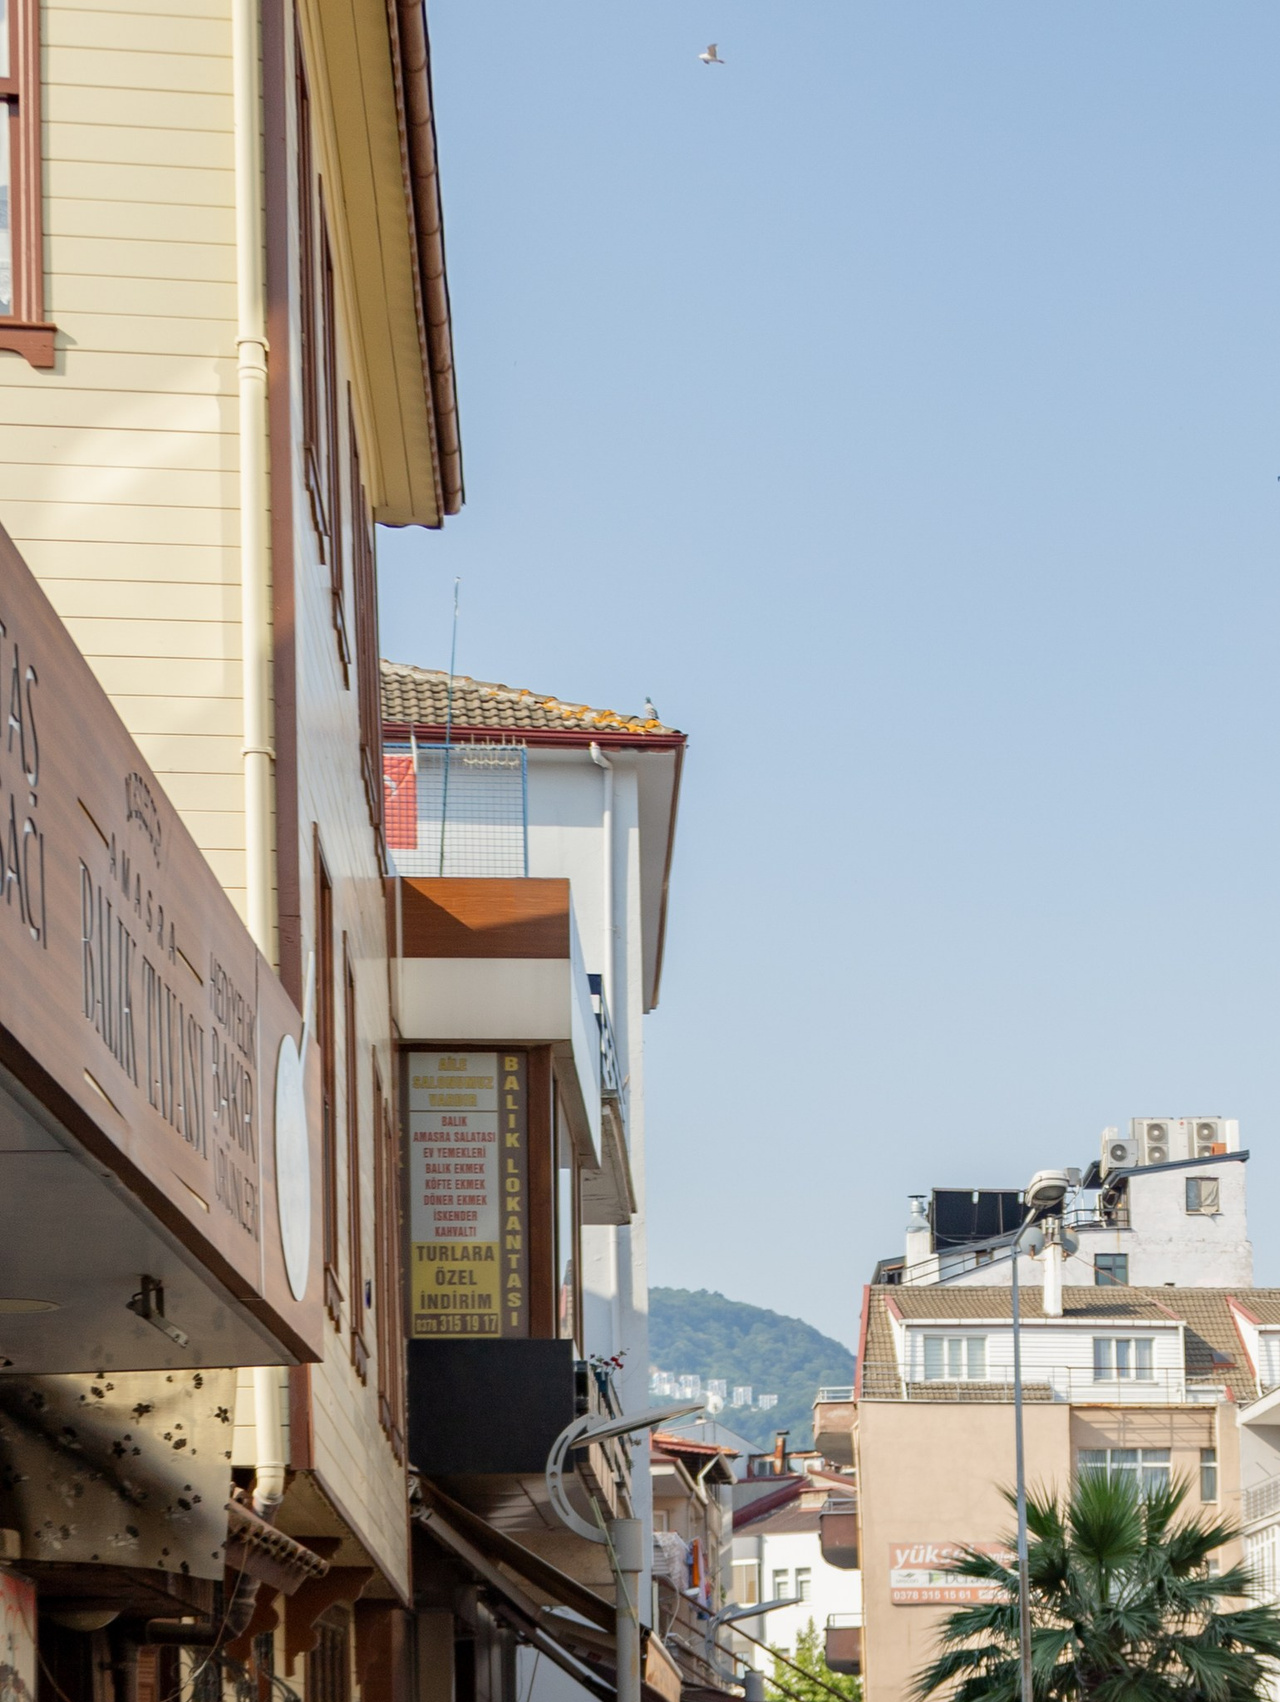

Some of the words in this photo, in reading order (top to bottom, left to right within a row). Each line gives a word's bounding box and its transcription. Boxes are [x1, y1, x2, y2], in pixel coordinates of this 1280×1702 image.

[0, 620, 40, 808] AŞ
[109, 832, 177, 965] AMASRA
[78, 857, 139, 1088] BALIK
[212, 1027, 256, 1163] BAKIR
[503, 1056, 520, 1148] BALIK
[441, 1116, 467, 1127] BALIK
[413, 1131, 451, 1142] AMASRA
[454, 1131, 496, 1142] SALATASI
[423, 1147, 433, 1158] EV
[425, 1163, 451, 1174] BALIK
[454, 1163, 485, 1174] EKMEK
[425, 1177, 452, 1190] KÖFTE
[455, 1179, 485, 1190] EKMEK
[423, 1193, 454, 1205] DÖNER
[456, 1195, 487, 1205] EKMEK
[435, 1226, 477, 1237] KAHVALTI
[505, 1158, 522, 1327] LOKANTASI
[416, 1245, 495, 1262] TURLARA
[435, 1266, 478, 1286] ÖZEL
[420, 1290, 492, 1310] İNDİRİM
[440, 1315, 461, 1332] 315
[466, 1315, 479, 1332] 19
[483, 1315, 497, 1332] 17
